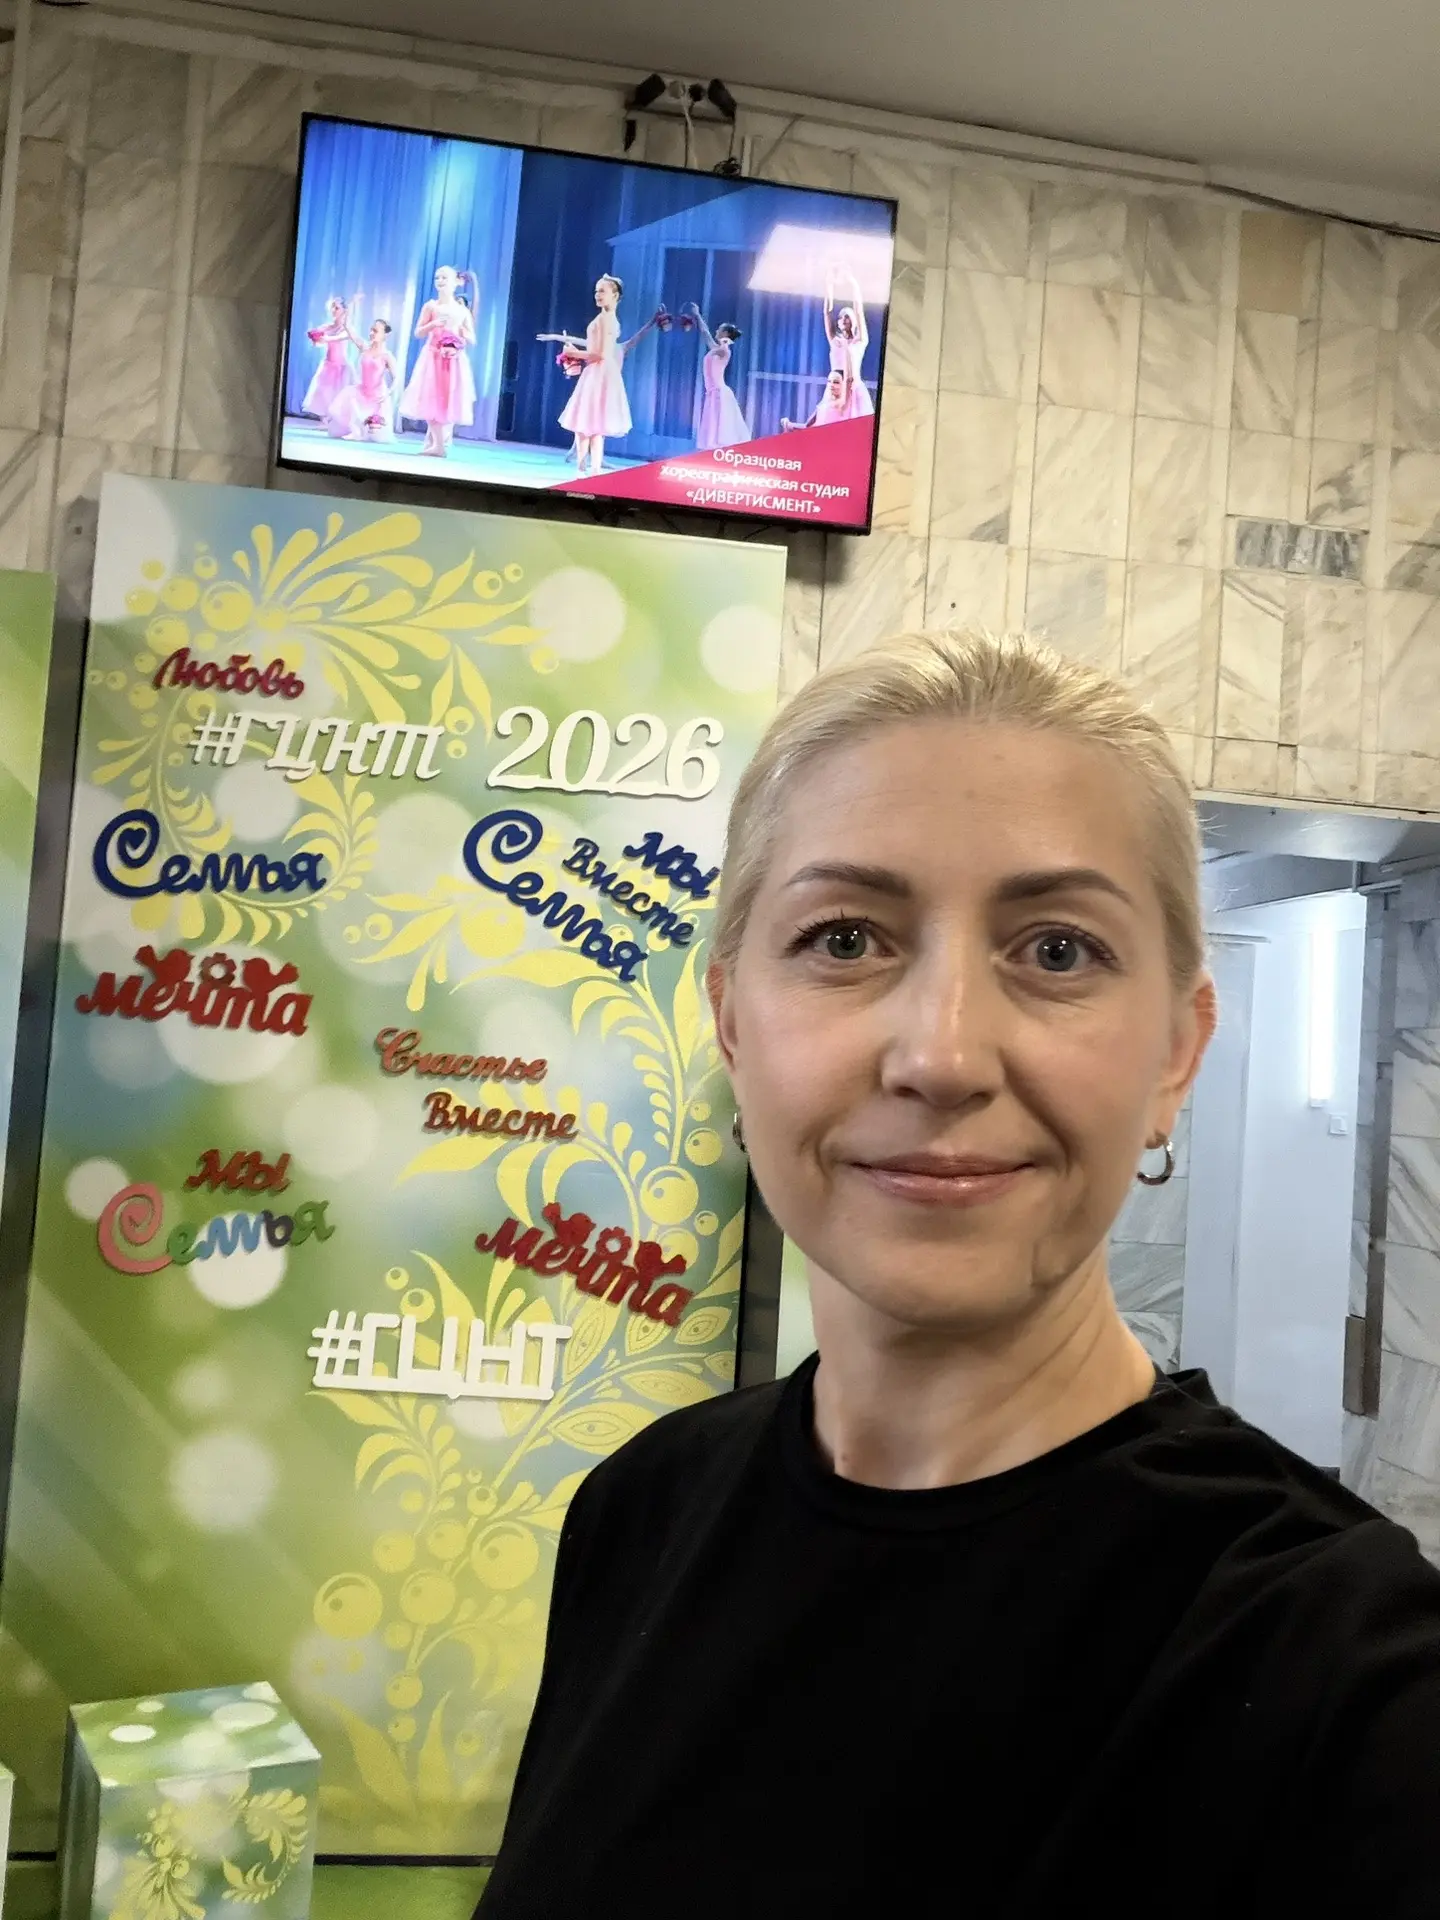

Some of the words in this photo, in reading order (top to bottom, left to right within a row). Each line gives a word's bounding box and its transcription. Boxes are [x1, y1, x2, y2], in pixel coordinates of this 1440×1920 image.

[713, 448, 802, 471] Образцовая
[800, 482, 849, 498] студия
[152, 646, 304, 699] Любовь
[486, 705, 724, 801] 2026
[93, 808, 327, 898] Семья
[462, 809, 648, 983] Семья
[562, 837, 695, 946] Вместе
[420, 1090, 580, 1142] Вместе
[96, 1182, 336, 1276] Семья
[307, 1309, 573, 1401] #ГЦНТ
